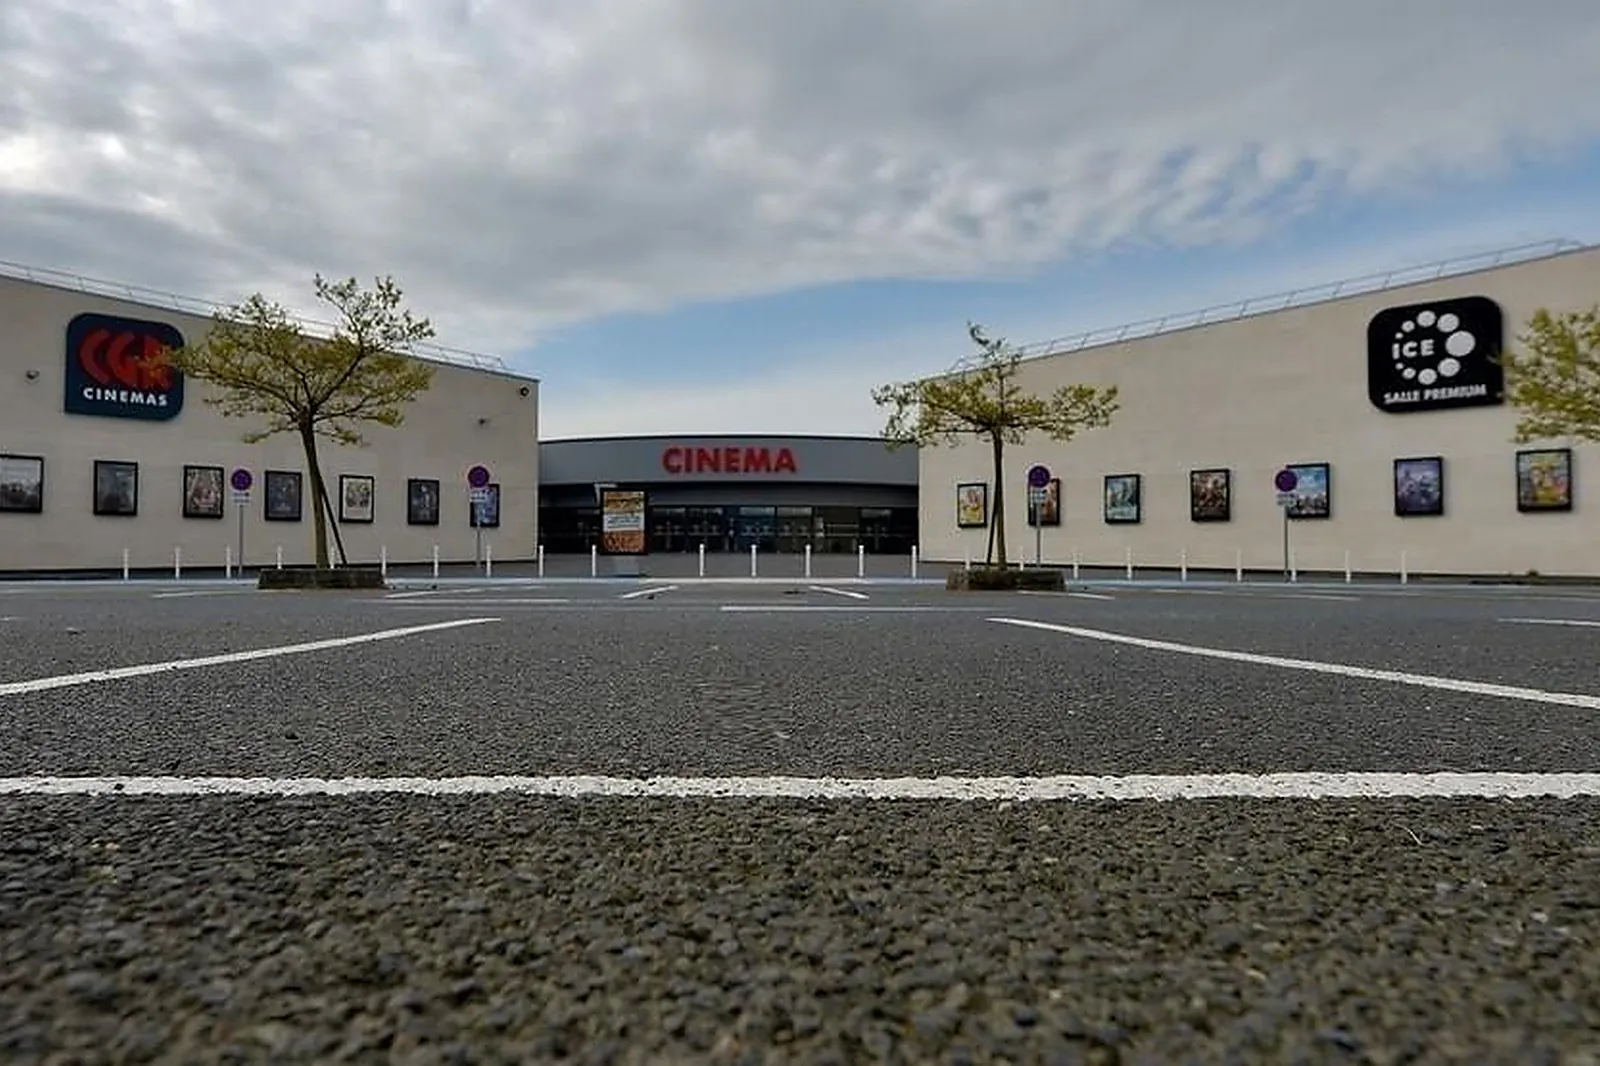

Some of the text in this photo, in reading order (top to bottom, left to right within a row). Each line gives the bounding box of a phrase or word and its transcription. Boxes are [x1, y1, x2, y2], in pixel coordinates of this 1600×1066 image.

[83, 387, 168, 407] CINEMAS
[1384, 385, 1486, 404] SALLE PREMIUM
[663, 448, 797, 474] CINEMA
